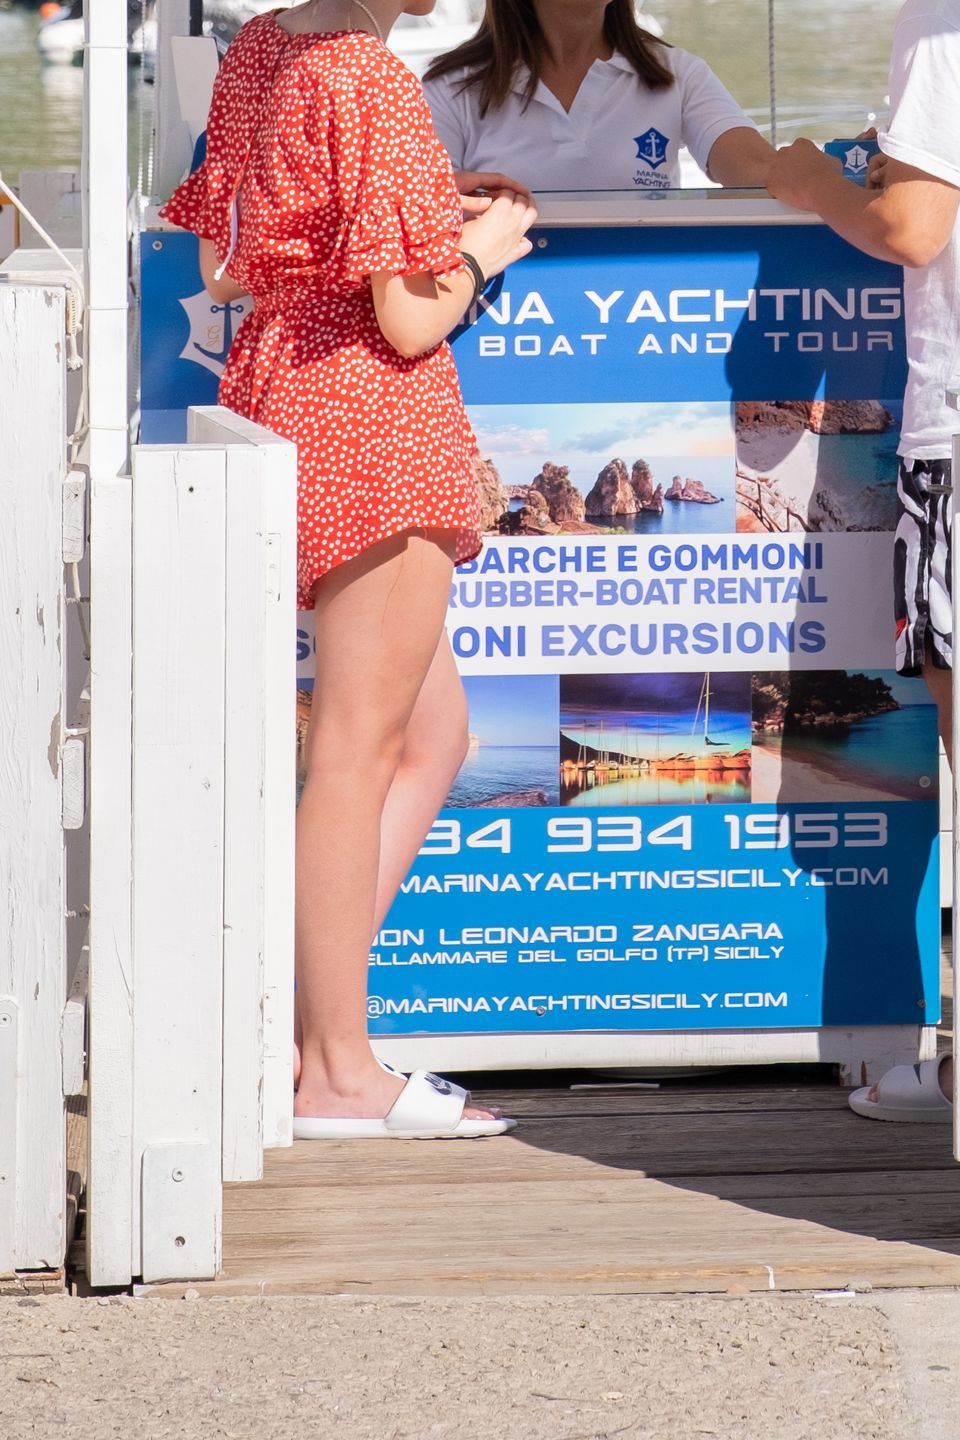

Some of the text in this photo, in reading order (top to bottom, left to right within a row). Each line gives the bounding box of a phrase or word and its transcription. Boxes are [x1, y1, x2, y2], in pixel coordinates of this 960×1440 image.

[460, 287, 901, 325] NA YACHTING
[479, 331, 894, 357] BOAT AND TOUR
[617, 545, 638, 572] E
[647, 543, 824, 572] GOMMONI
[693, 576, 829, 605] RENTAL
[540, 621, 828, 657] EXCURSIONS
[547, 814, 693, 854] 934
[724, 811, 889, 851] 1953
[370, 922, 784, 947] ON LEONARDO ZANGARA
[518, 949, 567, 964] DEL
[576, 947, 658, 962] GOLFO
[667, 945, 710, 962] (TP)
[714, 945, 785, 960] SICILY
[366, 991, 789, 1020] @MARINAYACHTINGSICILY.COM
